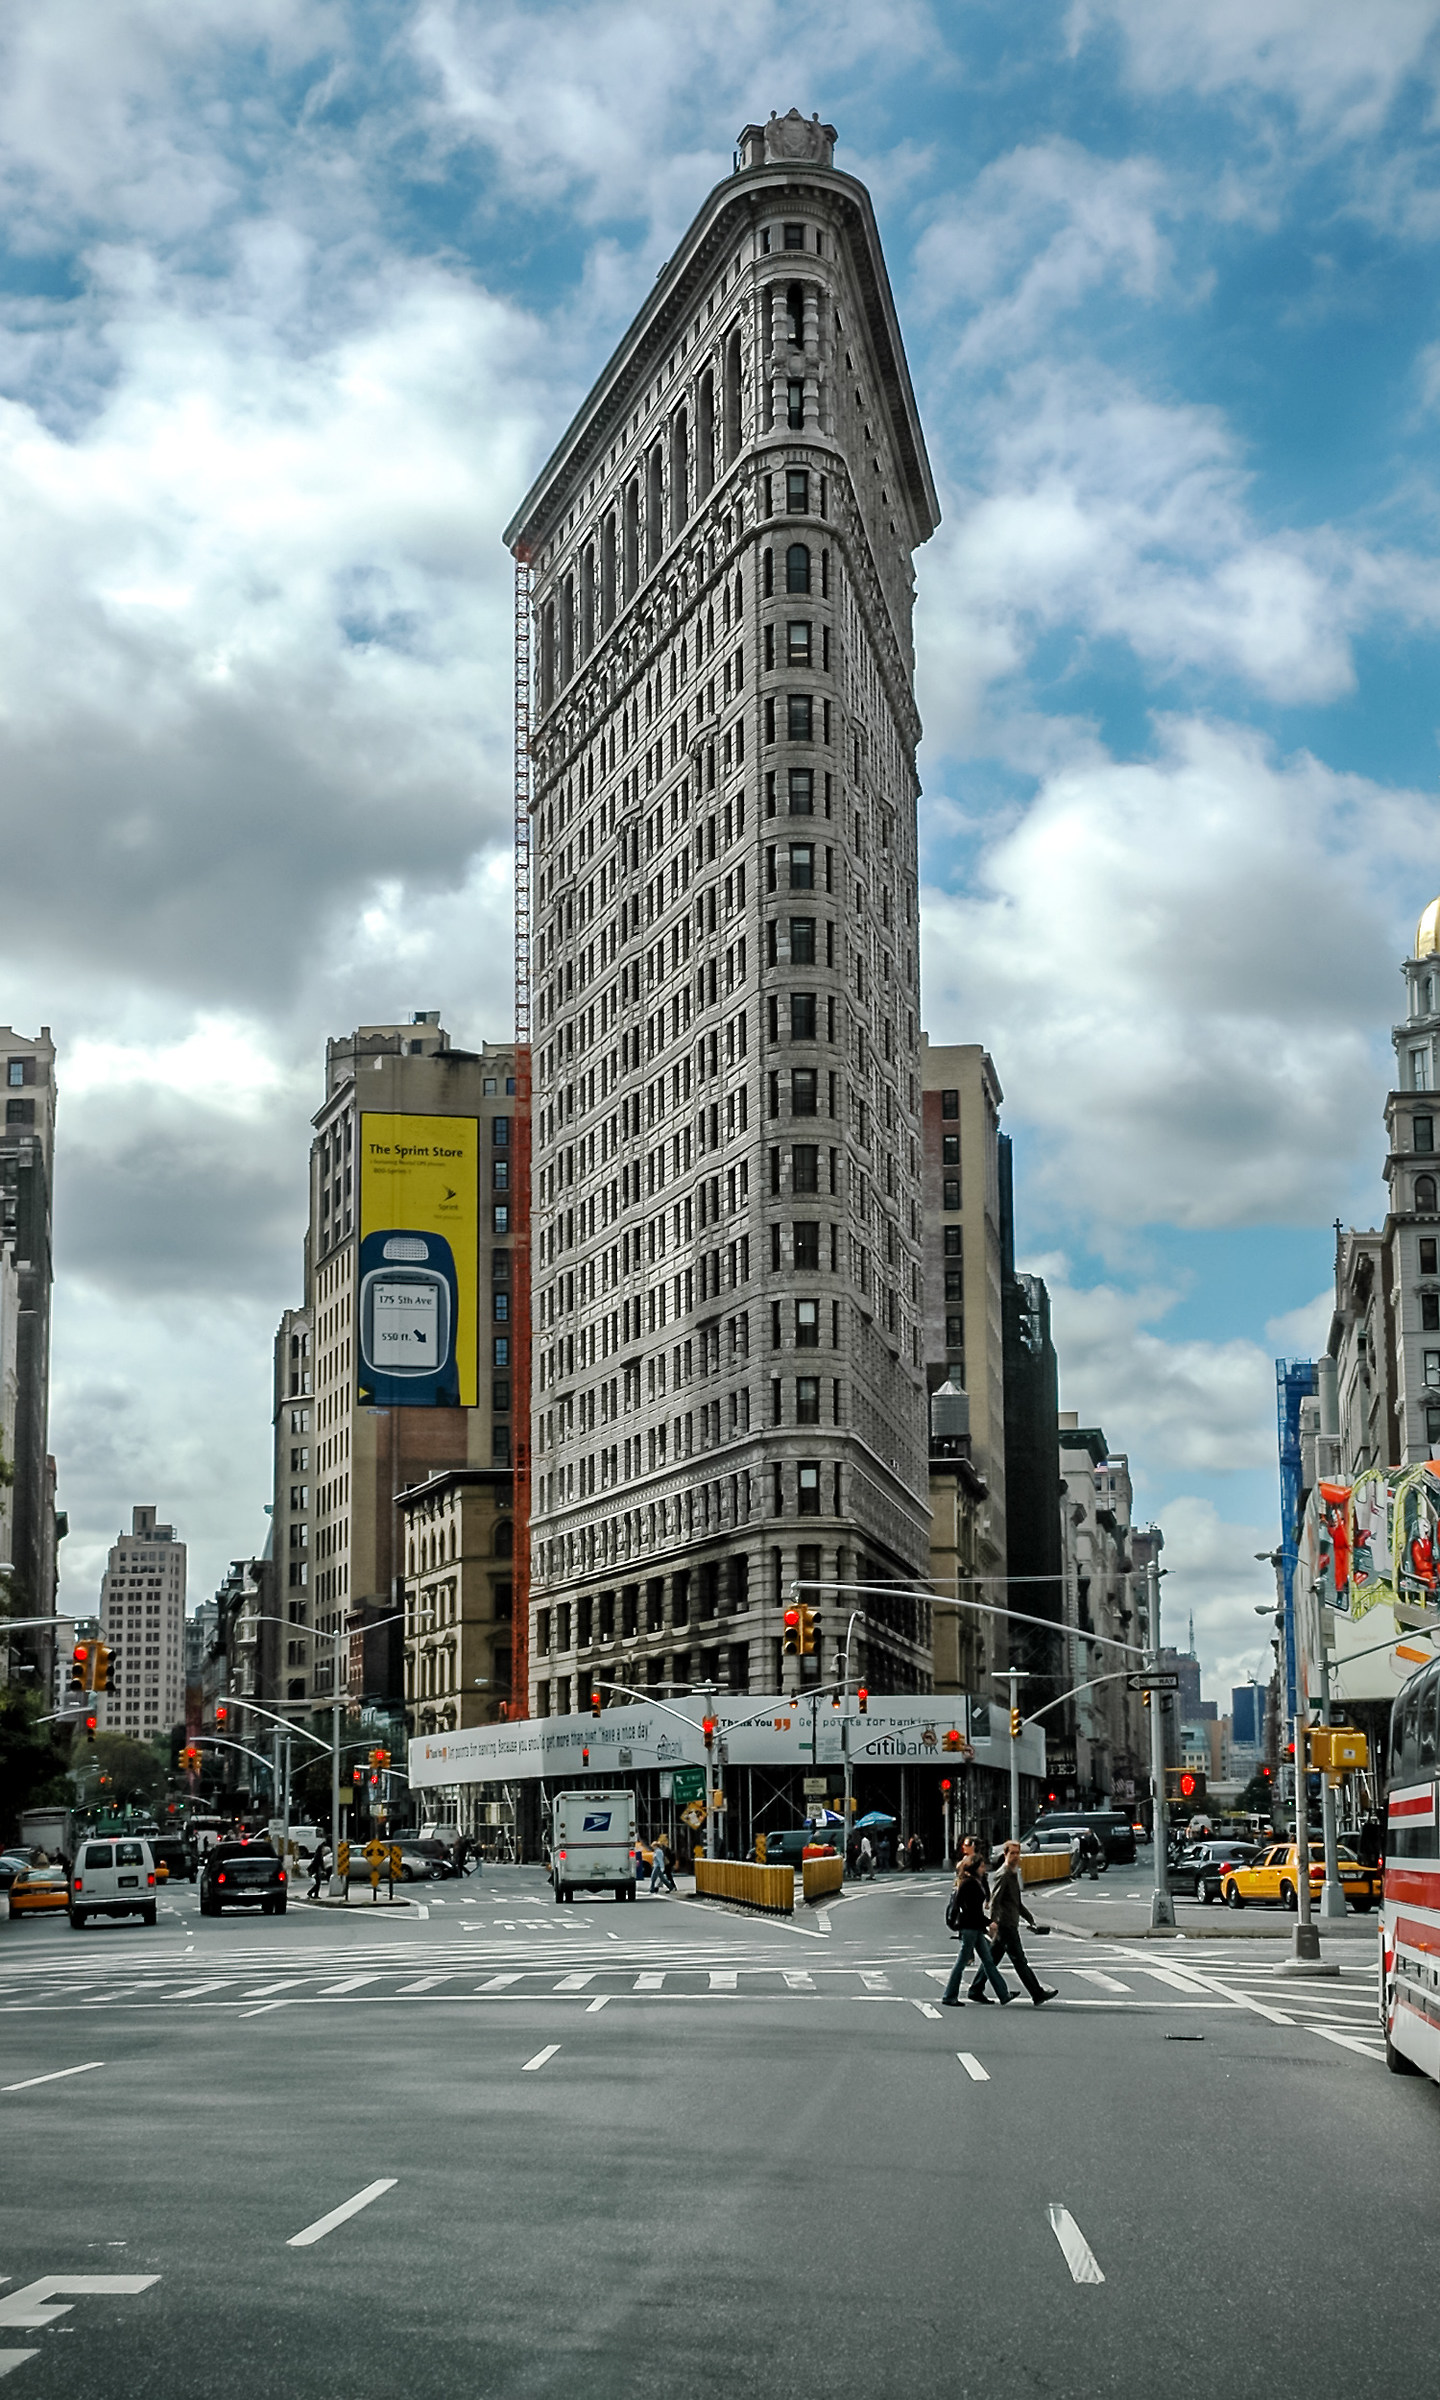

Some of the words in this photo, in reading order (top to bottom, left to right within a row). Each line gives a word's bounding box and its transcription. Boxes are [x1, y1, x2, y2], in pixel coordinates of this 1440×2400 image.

[369, 1144, 391, 1155] The
[394, 1144, 429, 1158] Sprint
[433, 1146, 463, 1158] Store
[379, 1295, 395, 1304] 175
[397, 1296, 413, 1305] 5th
[415, 1296, 432, 1305] Ave
[381, 1332, 398, 1341] 550
[1158, 1677, 1175, 1685] WAY
[753, 1718, 772, 1727] You
[823, 1717, 861, 1728] poits
[866, 1717, 886, 1727] for
[866, 1737, 939, 1756] citibank
